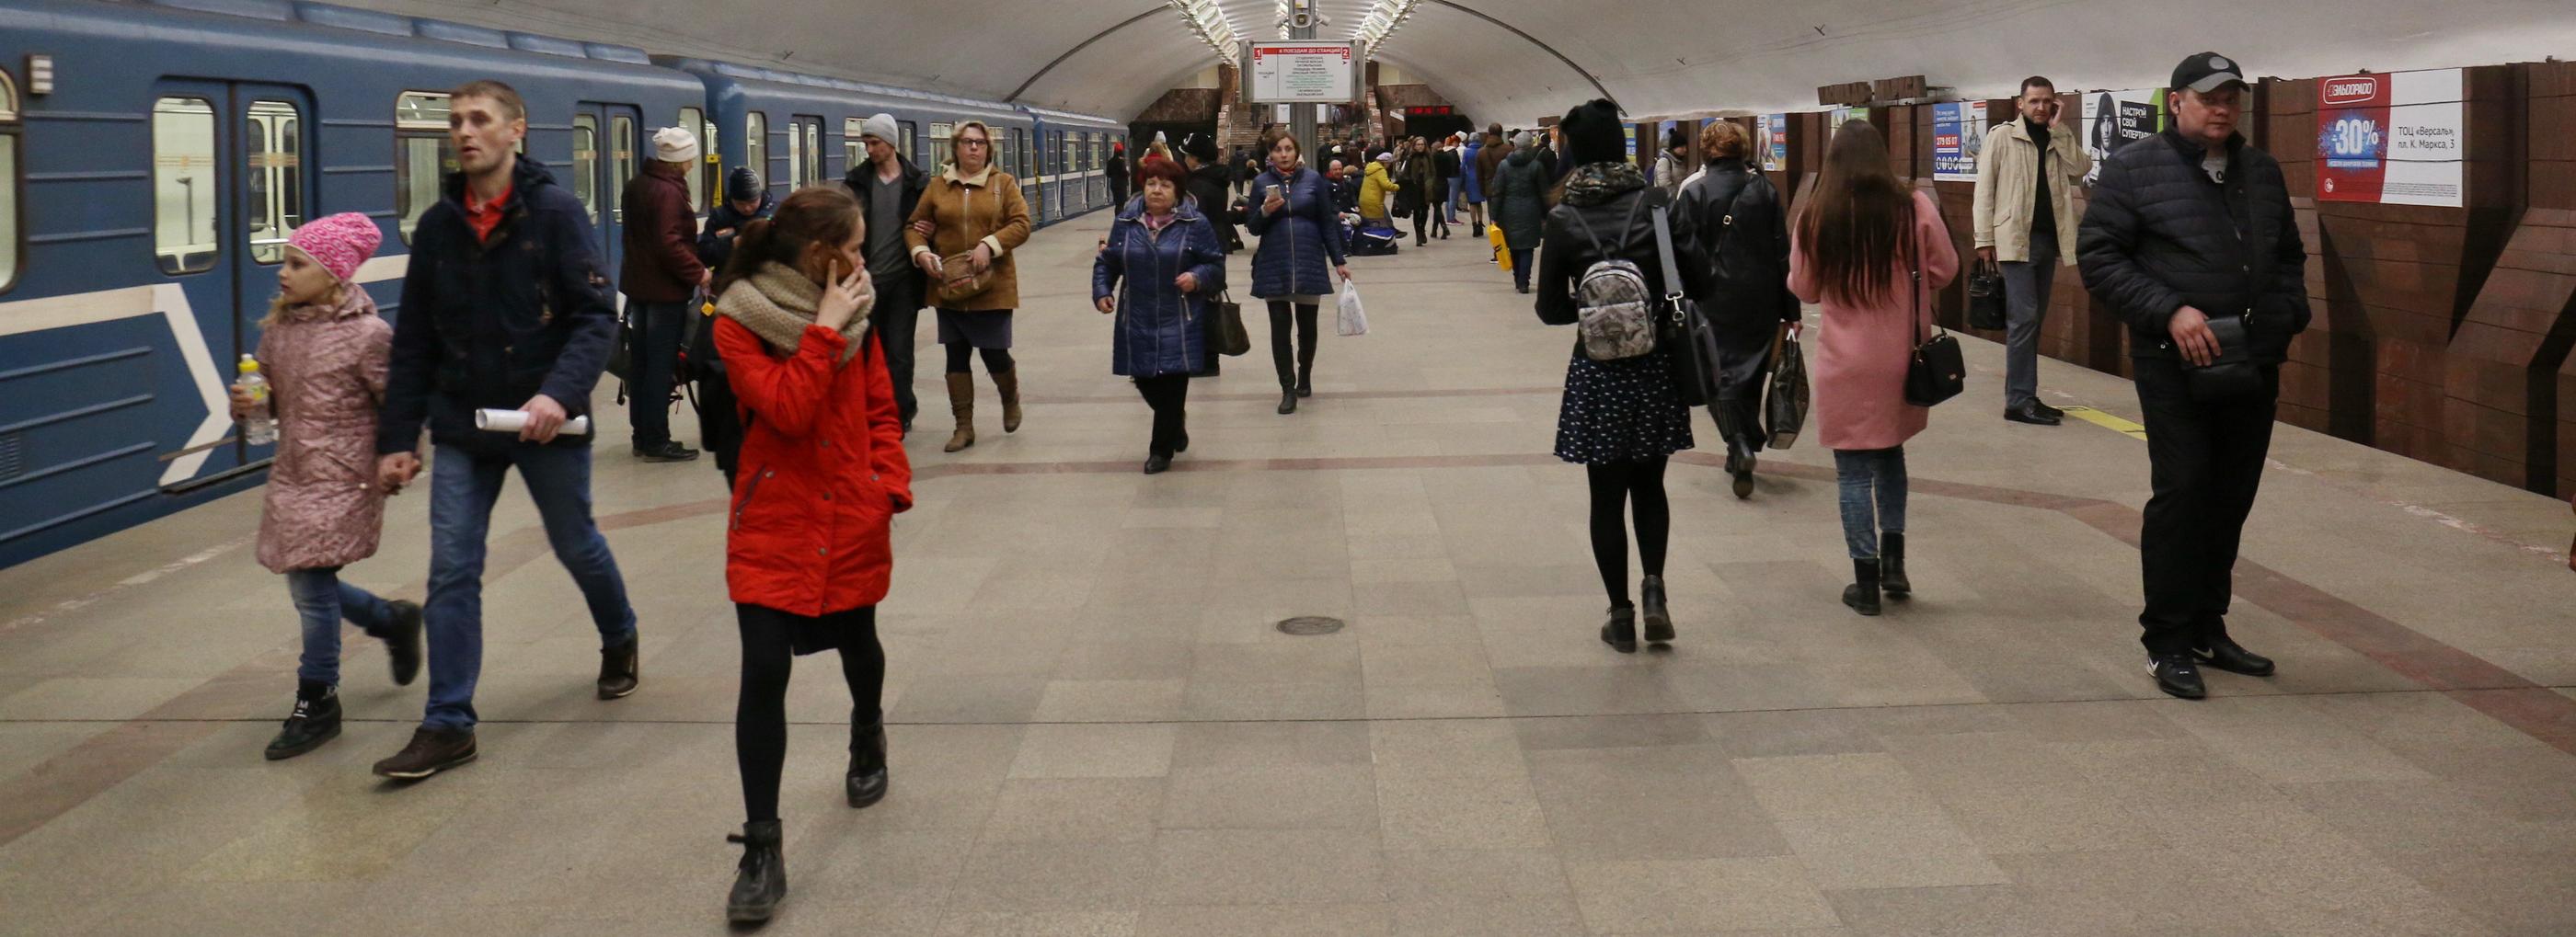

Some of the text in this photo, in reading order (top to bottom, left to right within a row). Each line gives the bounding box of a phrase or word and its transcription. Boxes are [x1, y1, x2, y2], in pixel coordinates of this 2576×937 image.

[2122, 106, 2147, 119] НАСТРОЙ
[2122, 117, 2137, 128] СВОЙ
[2330, 119, 2379, 155] -30%
[2398, 126, 2414, 137] ТОЦ
[2398, 140, 2409, 149] пл.
[2449, 139, 2455, 149] 3
